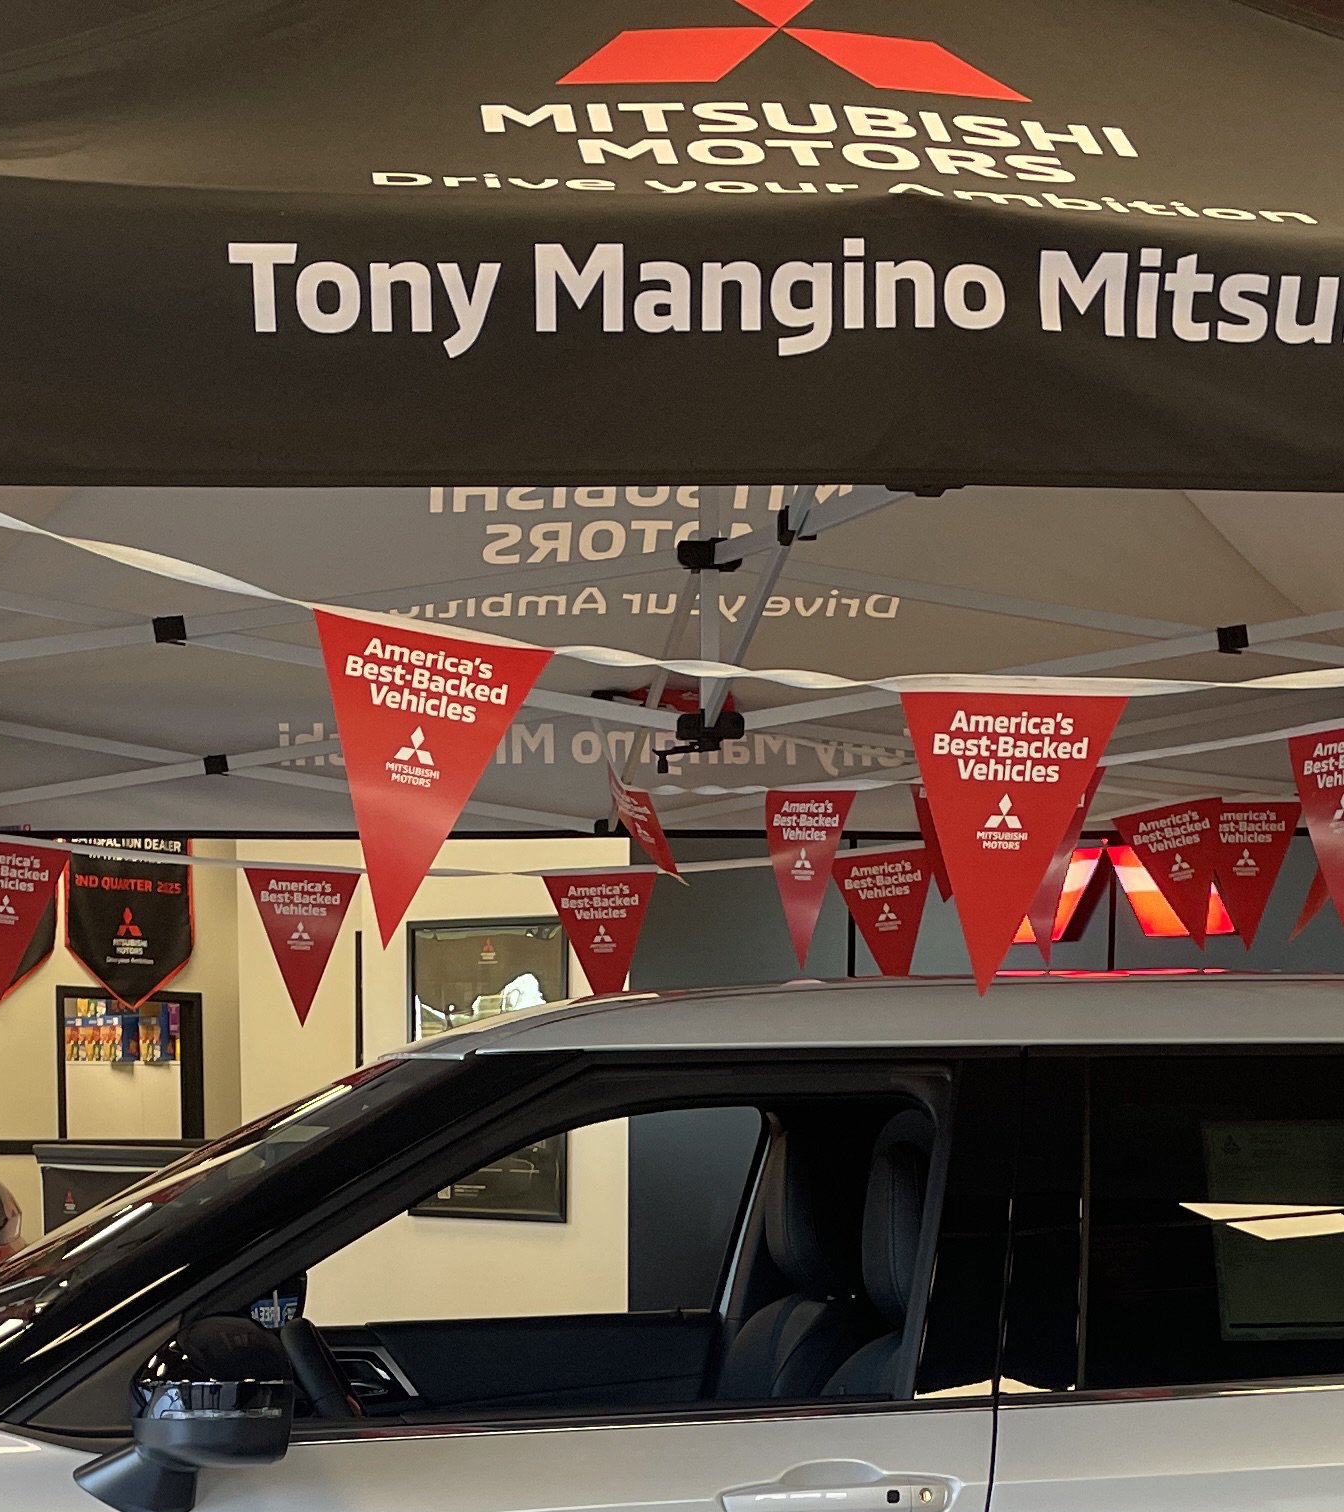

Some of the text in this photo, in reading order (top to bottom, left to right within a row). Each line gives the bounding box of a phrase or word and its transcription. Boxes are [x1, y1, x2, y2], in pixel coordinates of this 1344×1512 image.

[481, 101, 1138, 158] MITSUBISHI
[577, 137, 1076, 184] MOTORS
[372, 170, 616, 193] Drive
[645, 178, 861, 197] your
[228, 241, 502, 359] Tony
[536, 237, 1005, 357] Mangino
[364, 637, 493, 679] America's
[345, 655, 508, 705] Best-Backed
[369, 683, 476, 723] Vehicles
[950, 710, 1074, 736] America's
[932, 734, 1089, 760] Best-Backed
[385, 761, 440, 780] MITSUBISHI
[957, 759, 1060, 783] Vehicles
[391, 773, 431, 788] MOTORS
[781, 800, 833, 815] America's
[1219, 810, 1277, 822] merica's
[773, 814, 839, 828] Best-Backed
[1138, 810, 1200, 833] America's
[782, 827, 827, 842] Vehicles
[976, 831, 1028, 841] MITSUBISHI
[1132, 818, 1211, 846] Best-Backed
[1220, 831, 1272, 844] Vehicles
[144, 838, 182, 853] DEALER
[982, 840, 1020, 850] MOTORS
[1147, 833, 1200, 854] Vehicles
[850, 860, 912, 877] America's
[102, 876, 152, 893] QUARTER
[268, 879, 332, 893] America's
[844, 871, 922, 890] Best-Backed
[260, 890, 340, 905] Best-Backed
[567, 883, 629, 897] America's
[858, 884, 910, 900] Vehicles
[561, 893, 639, 908] Best-Backed
[273, 903, 327, 917] Vehicles
[574, 906, 627, 920] Vehicles
